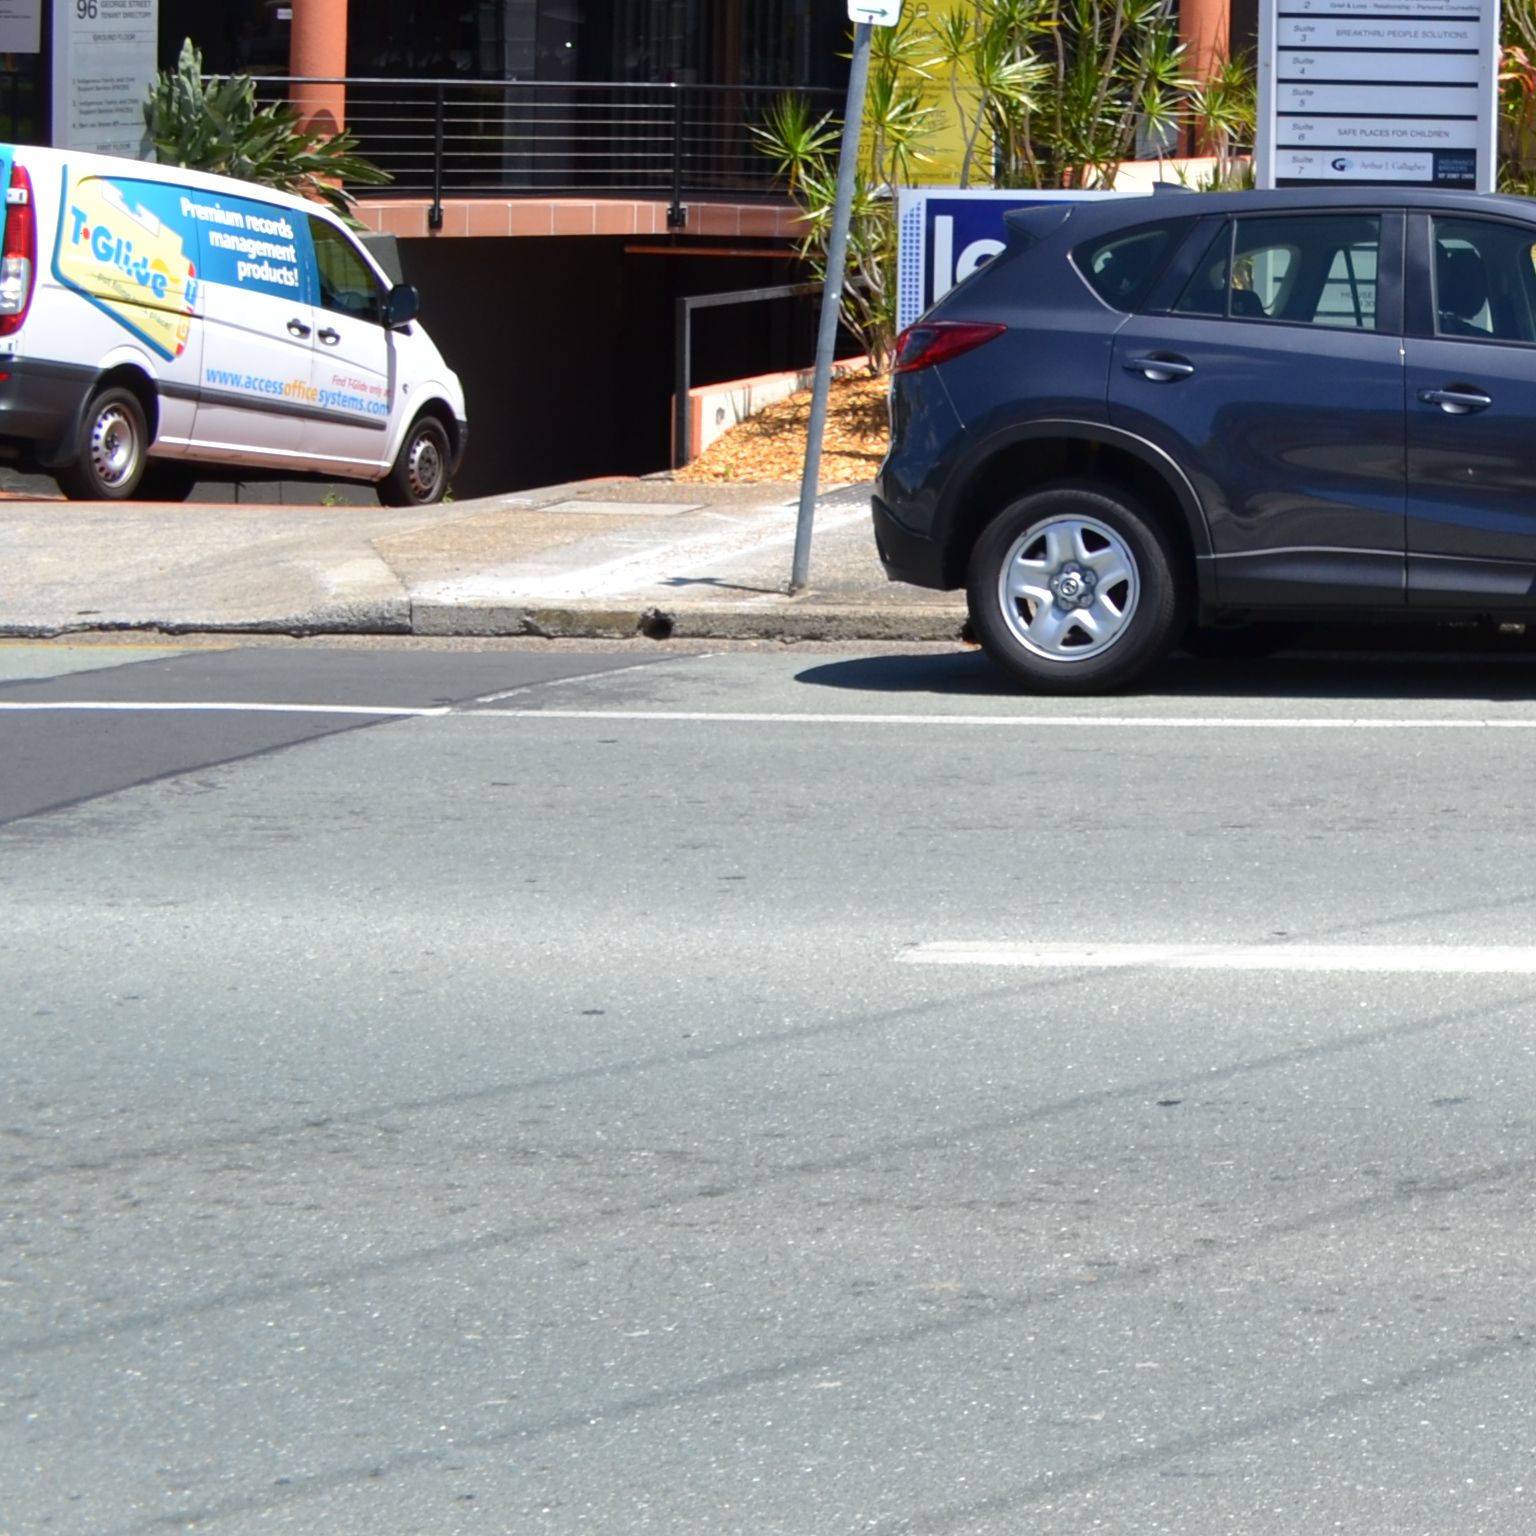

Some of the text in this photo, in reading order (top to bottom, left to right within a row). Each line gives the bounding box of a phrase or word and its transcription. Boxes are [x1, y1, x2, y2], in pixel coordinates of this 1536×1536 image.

[1387, 30, 1419, 39] PEOPLE
[1421, 31, 1468, 40] SOLUTIONS
[1338, 128, 1450, 138] SAFE PLACES FOR CHILDREN
[179, 196, 294, 240] Premium records
[209, 230, 297, 264] management
[237, 260, 300, 288] products!
[206, 368, 391, 416] www.accessofficesystems.com
